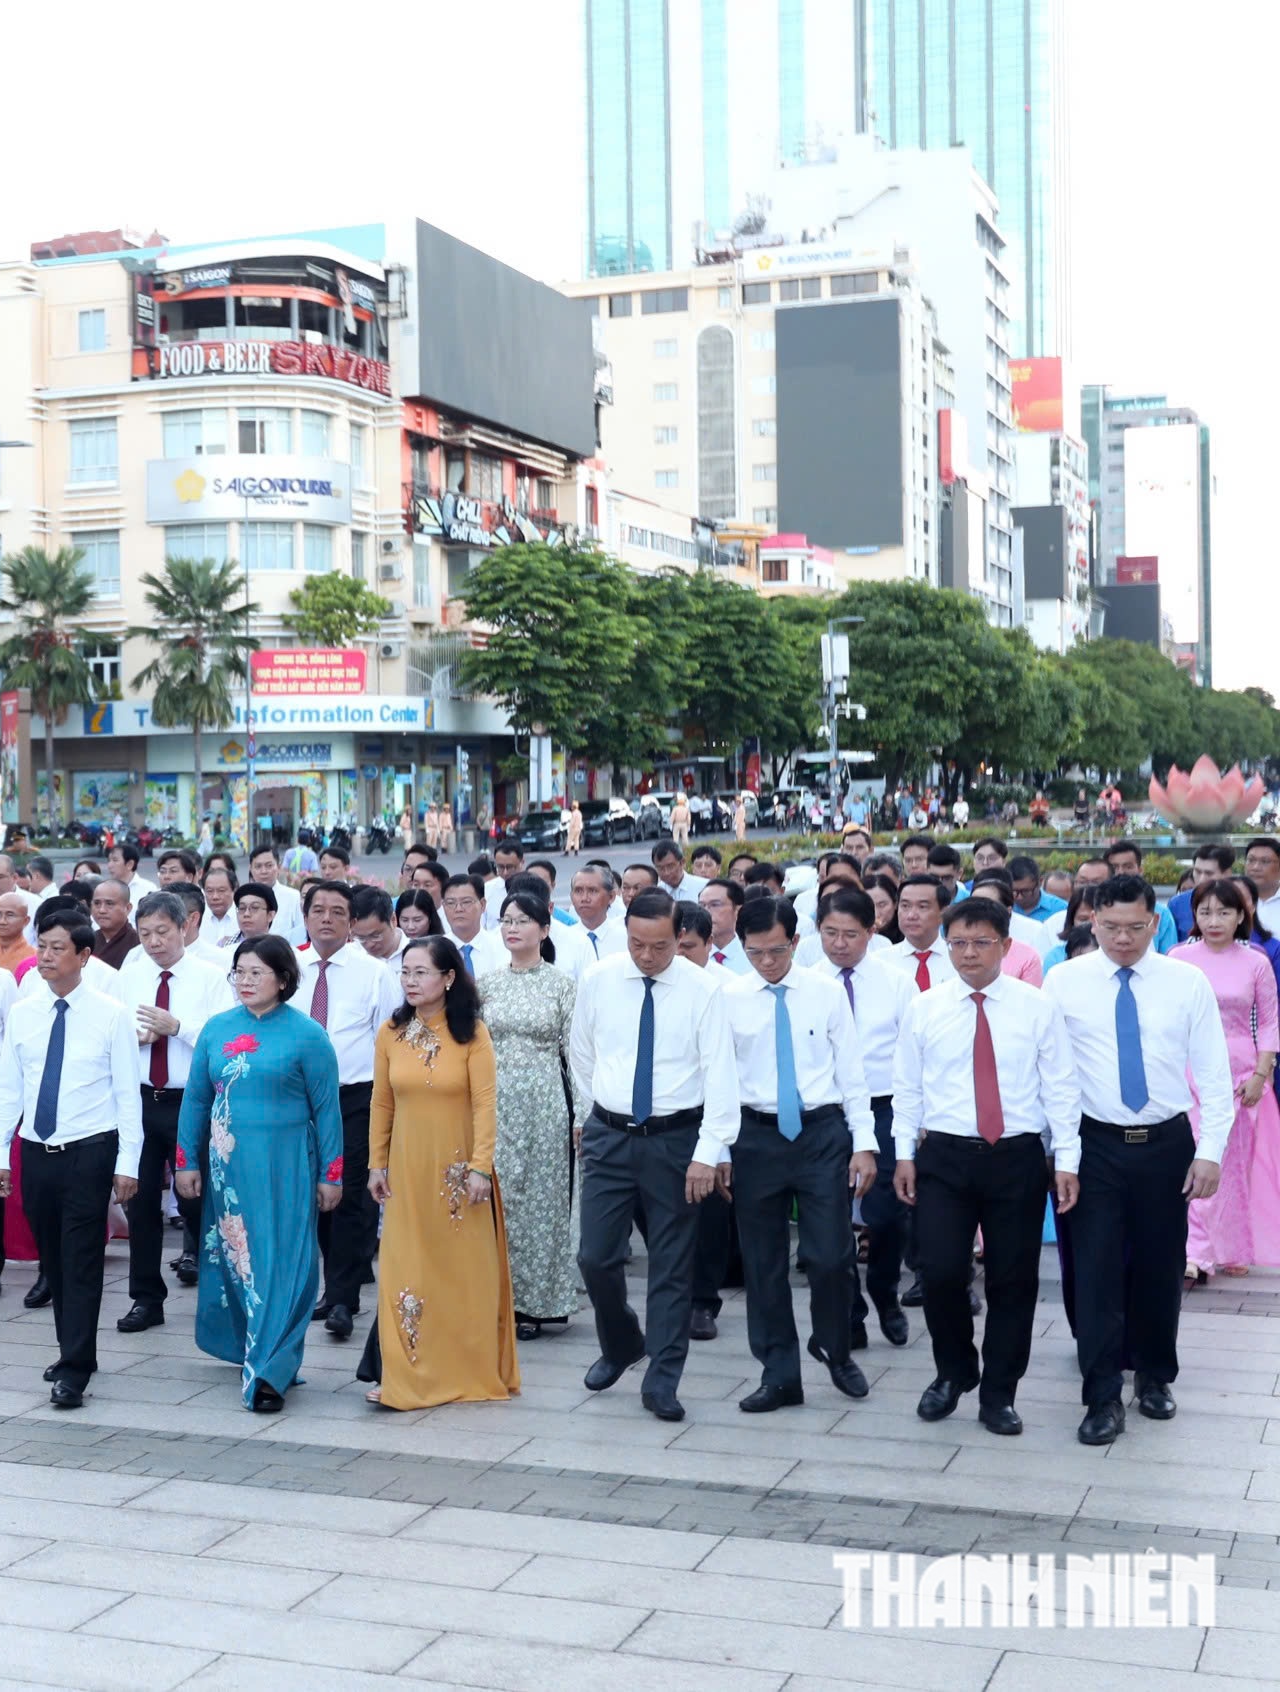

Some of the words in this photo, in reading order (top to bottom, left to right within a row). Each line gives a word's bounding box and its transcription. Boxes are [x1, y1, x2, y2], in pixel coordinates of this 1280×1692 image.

[189, 266, 231, 283] SAIGON
[160, 344, 205, 377] FOOD
[208, 348, 221, 371] &
[223, 342, 271, 373] BEER
[271, 340, 344, 378] SKY
[344, 351, 392, 397] ZONE
[456, 496, 482, 524] CHILL
[235, 704, 373, 724] Information
[379, 704, 418, 723] Center
[248, 743, 332, 757] AIGONTOURIST
